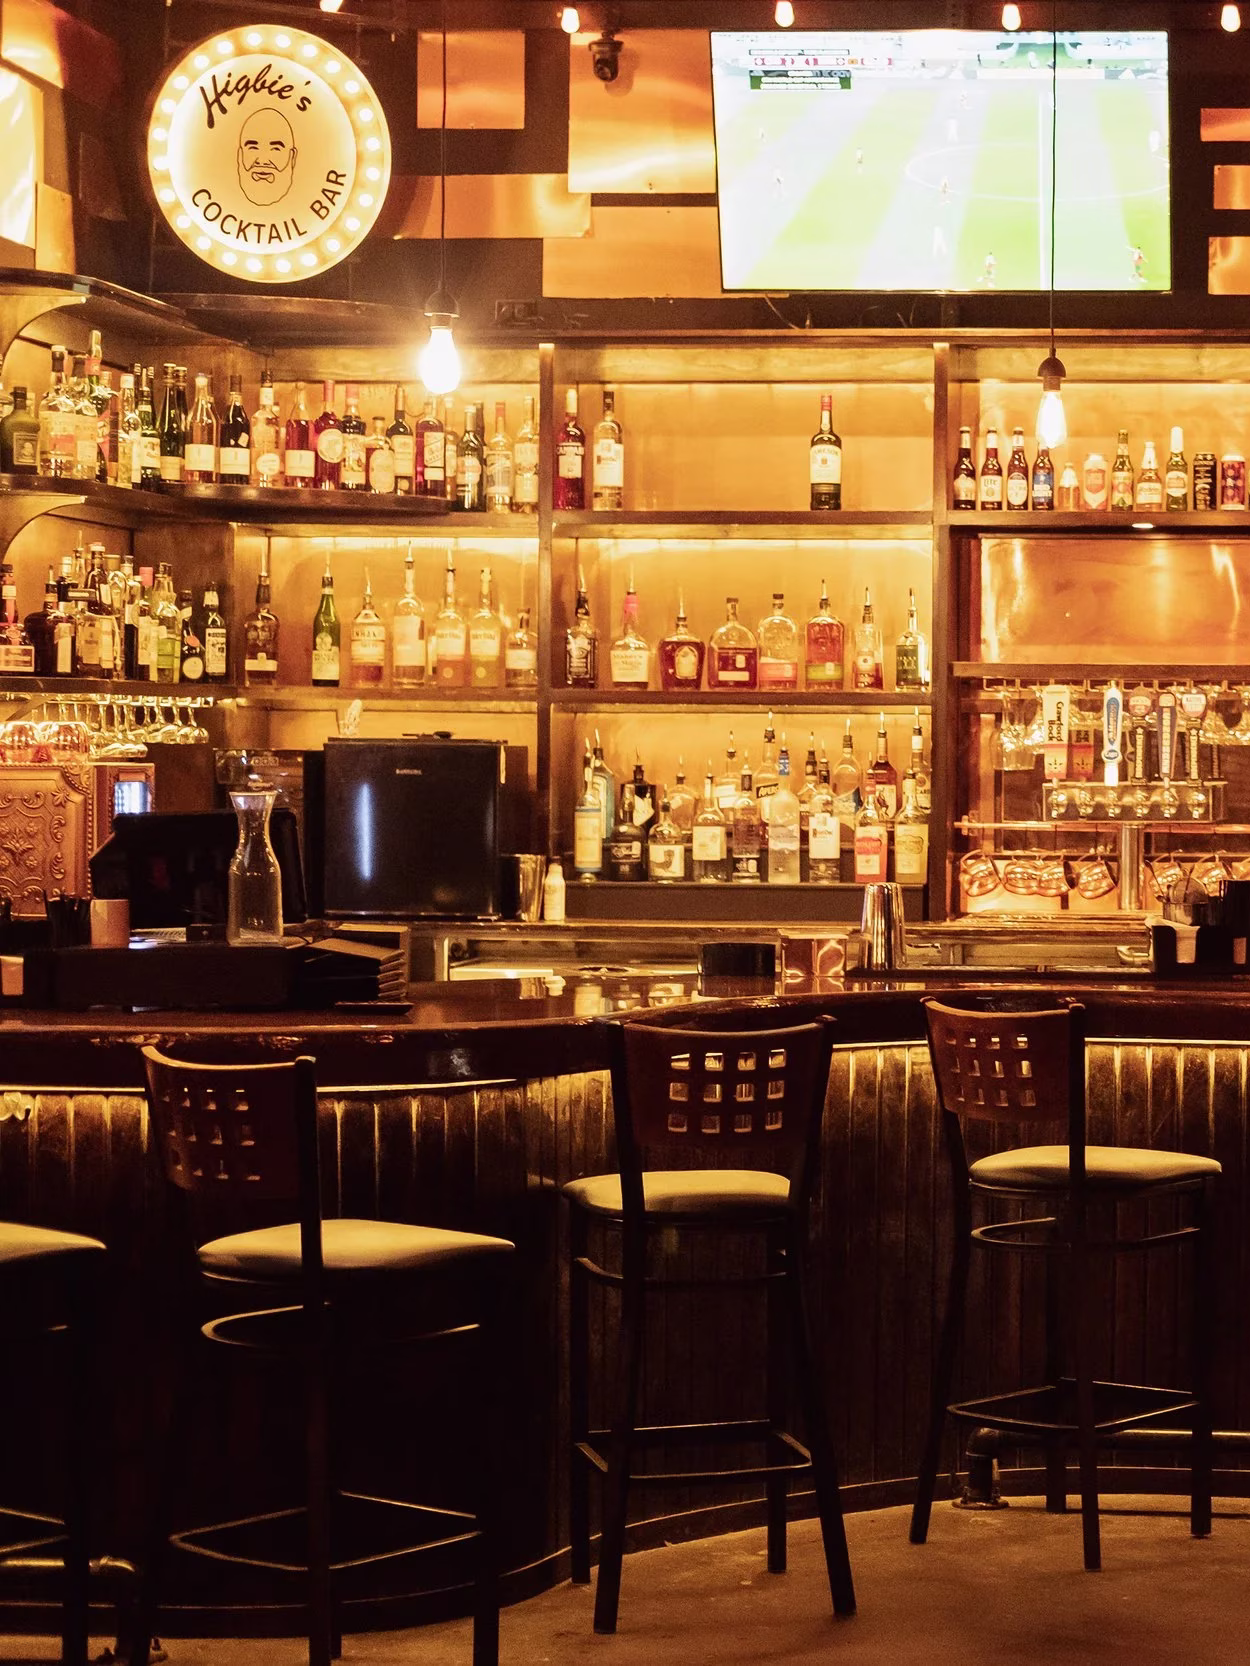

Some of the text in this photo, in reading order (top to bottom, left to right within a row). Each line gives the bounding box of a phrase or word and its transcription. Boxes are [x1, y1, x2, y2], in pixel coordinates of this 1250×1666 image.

[200, 63, 312, 129] Higbie's
[192, 169, 347, 245] COCKTAIL BAR
[1047, 719, 1056, 742] Bock
[1055, 701, 1065, 742] Crawford
